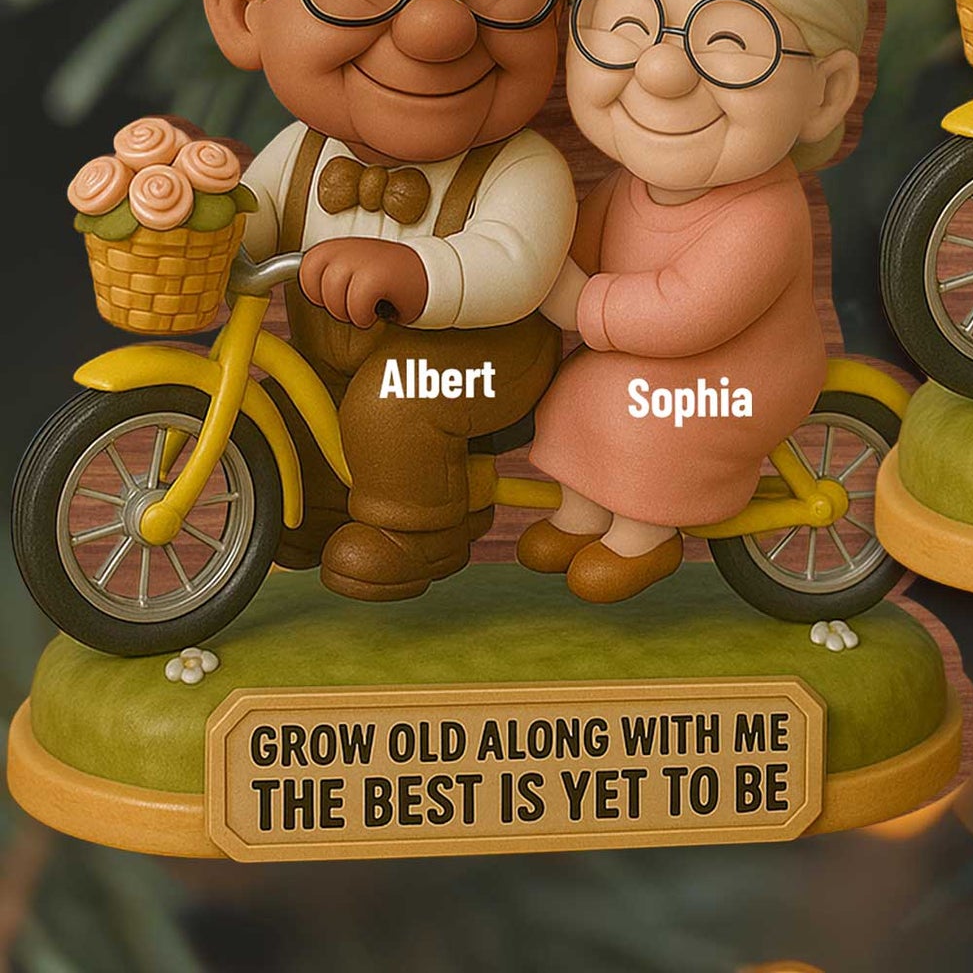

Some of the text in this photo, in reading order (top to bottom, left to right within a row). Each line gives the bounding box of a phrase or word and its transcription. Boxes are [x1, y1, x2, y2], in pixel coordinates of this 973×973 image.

[378, 359, 496, 399] Albert
[628, 377, 753, 428] Sophia
[250, 713, 789, 767] GROW OLD ALONG WITH ME
[251, 763, 789, 831] THE BEST IS YET TO BE
